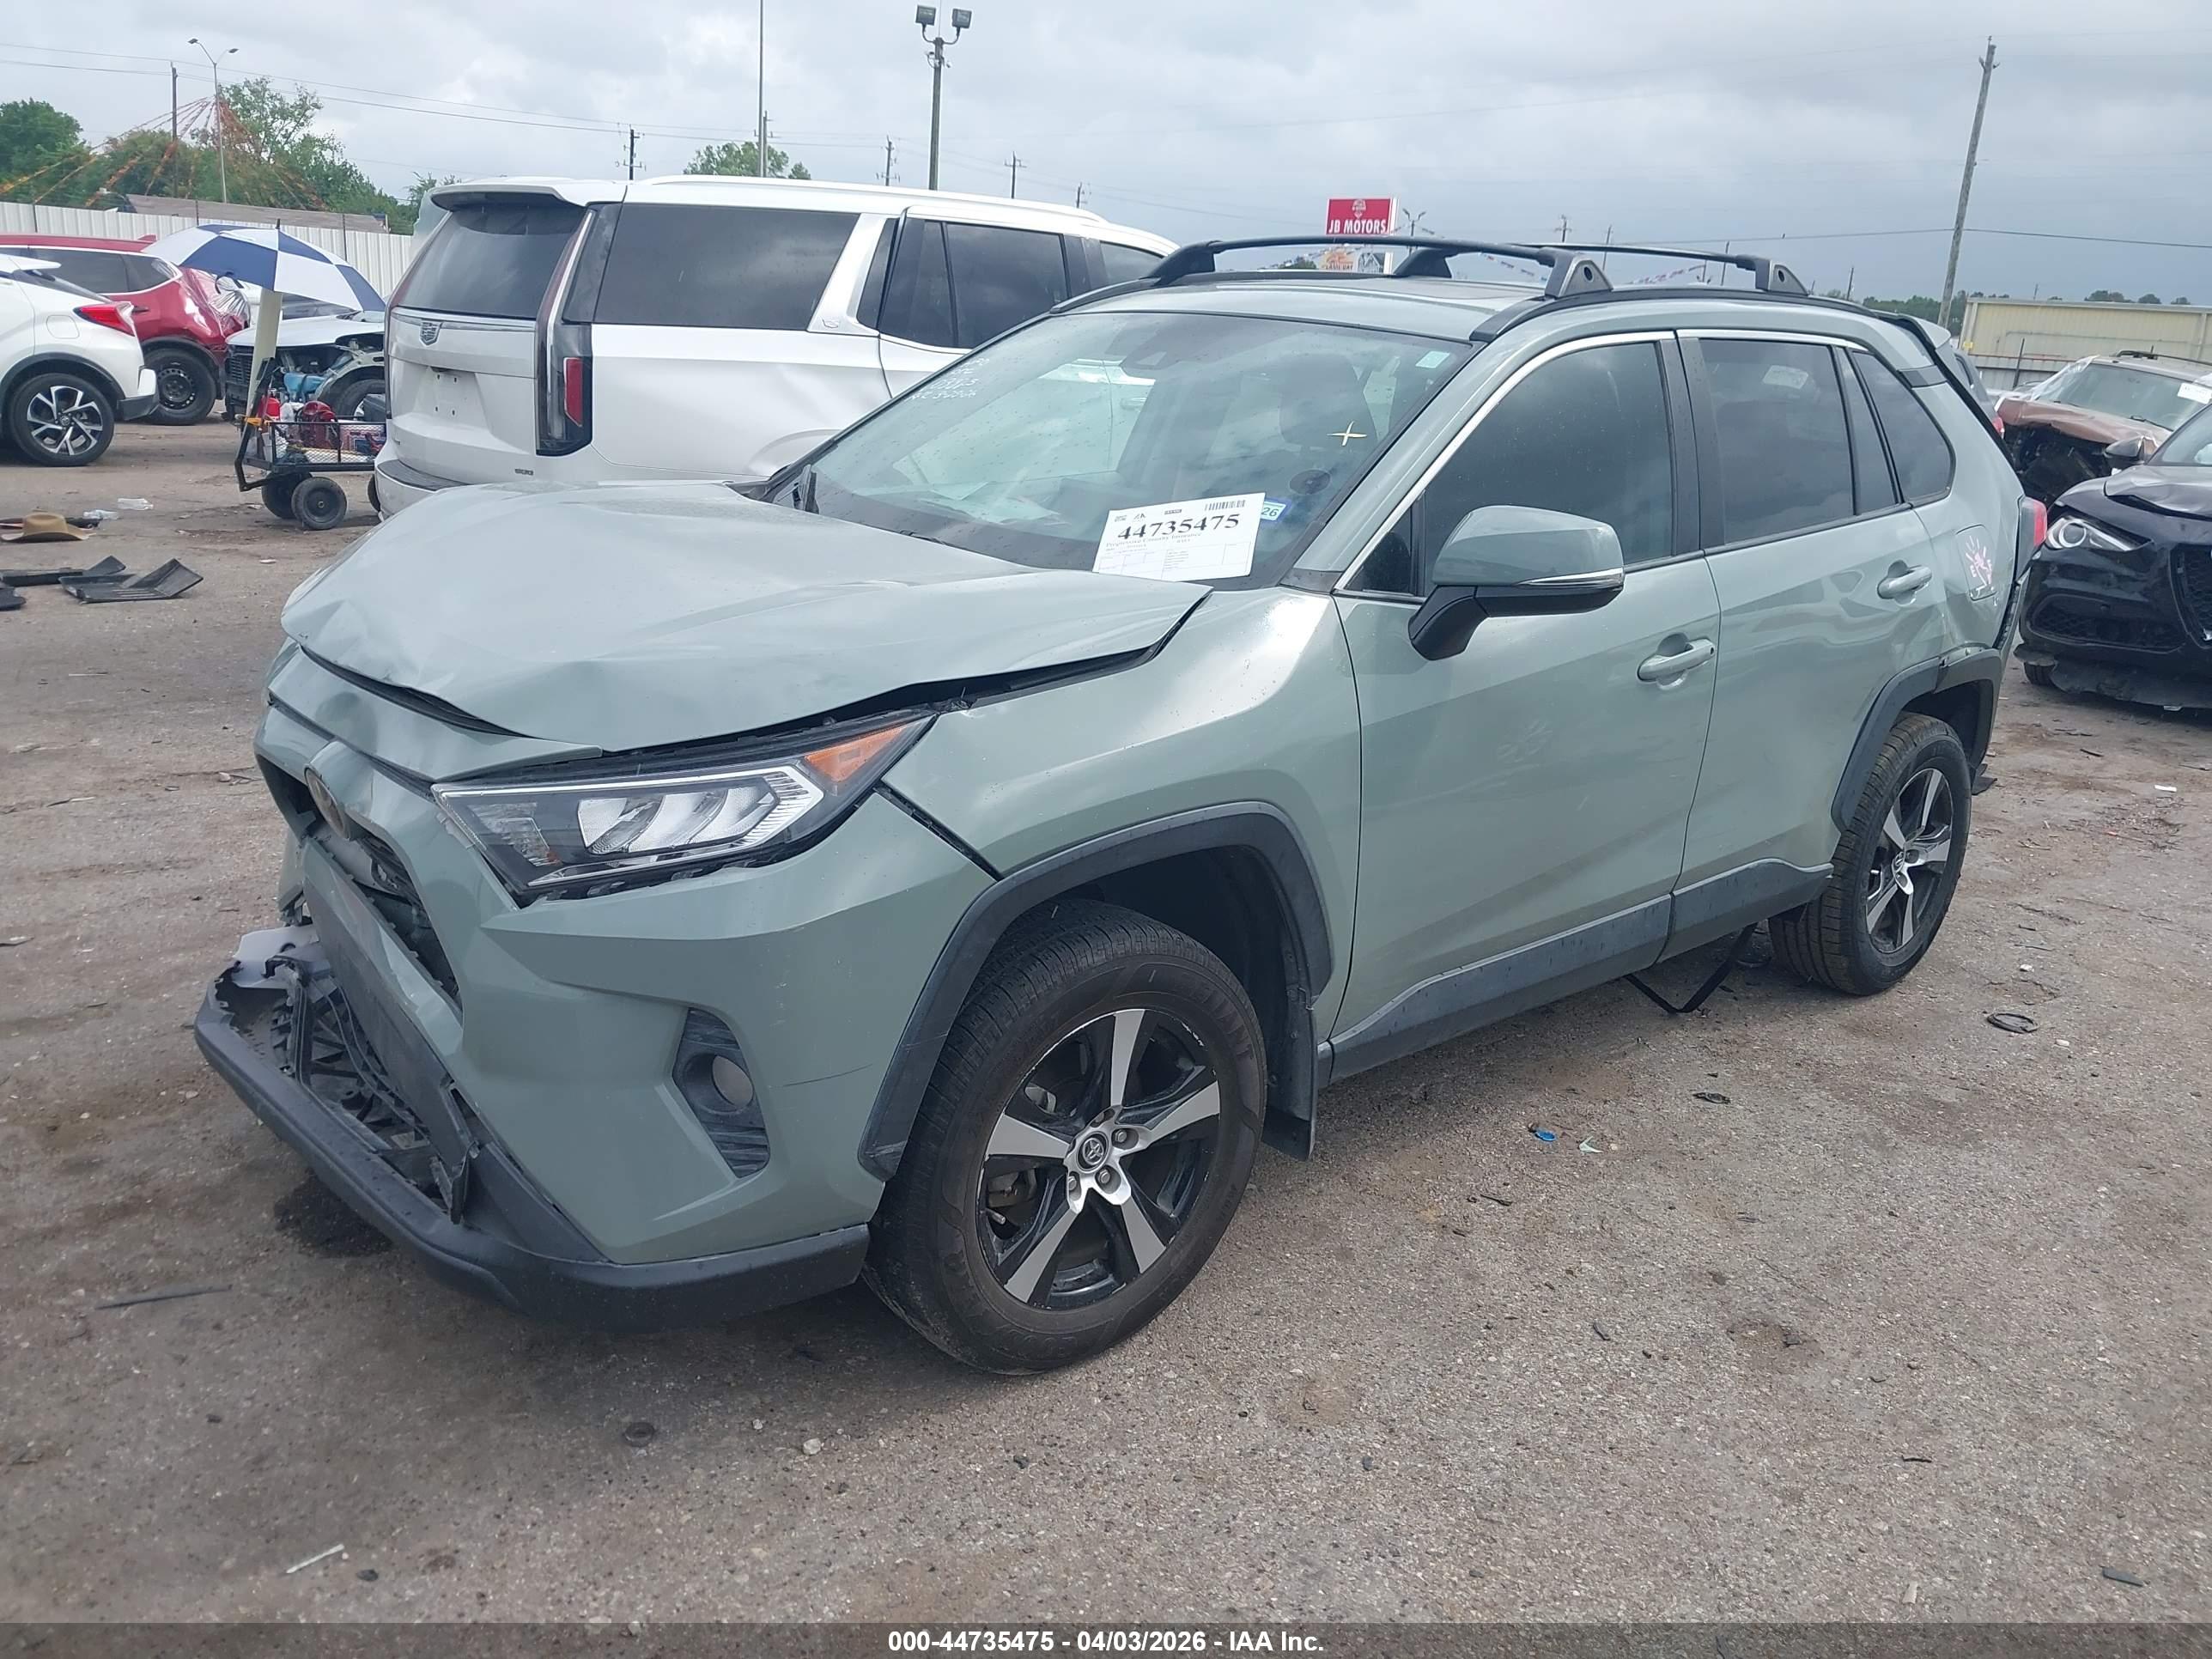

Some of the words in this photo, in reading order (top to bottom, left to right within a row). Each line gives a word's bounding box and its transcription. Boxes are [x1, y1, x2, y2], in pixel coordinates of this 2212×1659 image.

[1328, 219, 1340, 234] JB
[1343, 219, 1386, 234] MOTORS
[1261, 507, 1279, 517] 26
[1117, 514, 1240, 539] 44735475
